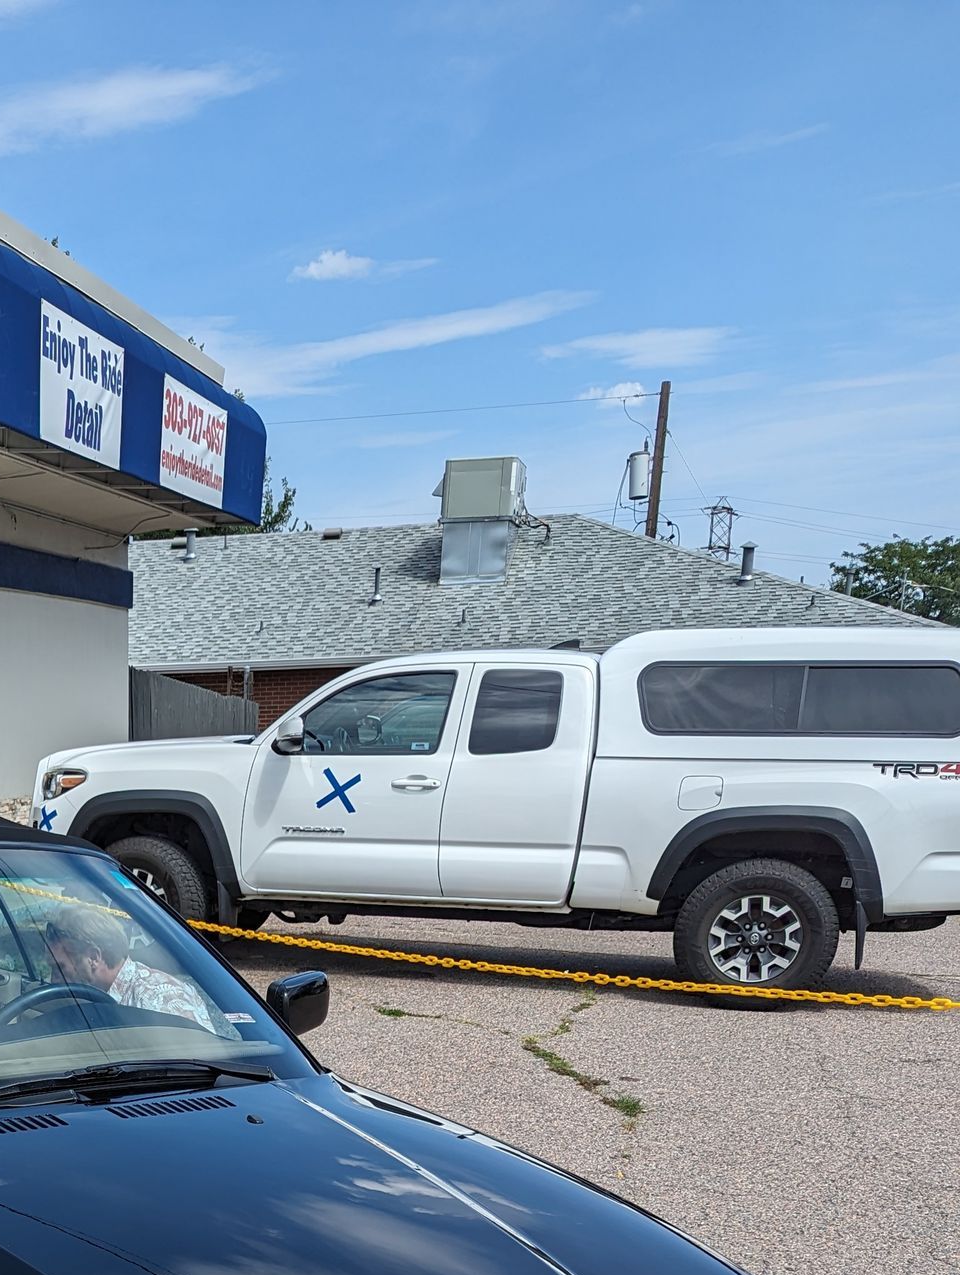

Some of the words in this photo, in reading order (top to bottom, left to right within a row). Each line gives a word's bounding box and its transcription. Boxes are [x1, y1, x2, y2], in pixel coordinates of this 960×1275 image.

[42, 314, 76, 380] Enjoy
[78, 335, 98, 384] The
[100, 348, 122, 398] Ride
[64, 388, 104, 452] Detail
[163, 388, 226, 457] 303-927-6037
[873, 763, 939, 779] TRD
